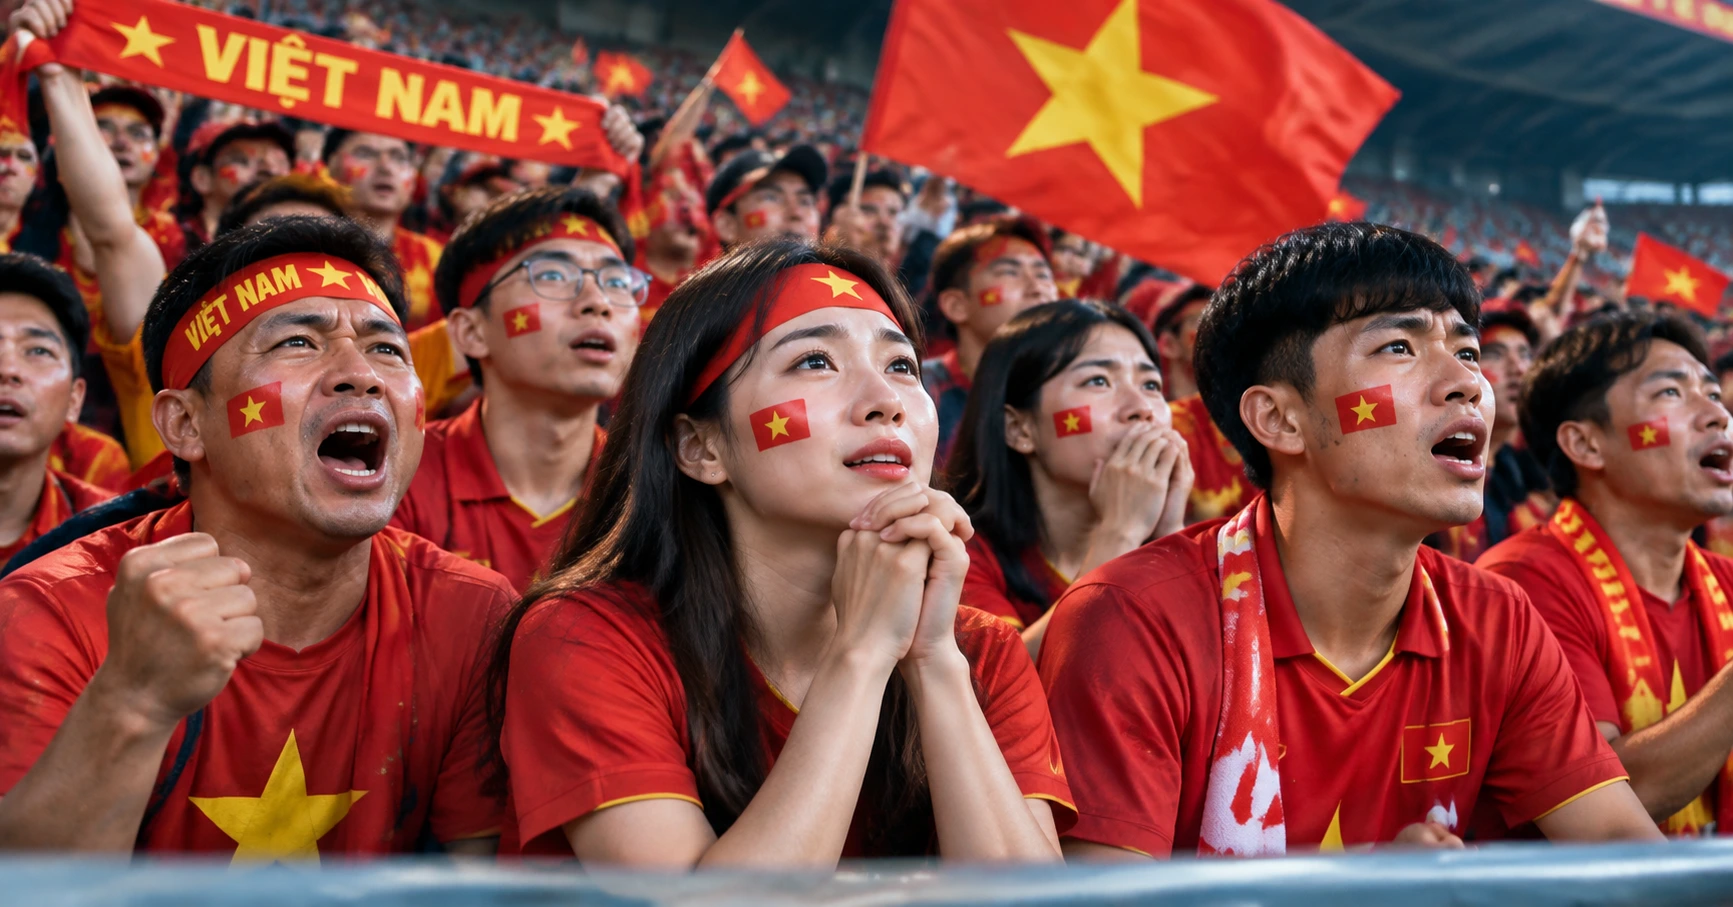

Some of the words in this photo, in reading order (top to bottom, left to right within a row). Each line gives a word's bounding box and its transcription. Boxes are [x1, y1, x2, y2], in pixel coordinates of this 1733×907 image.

[197, 24, 358, 108] VIỆT
[375, 67, 522, 142] NAM
[184, 294, 231, 351] VIỆT
[234, 264, 303, 312] NAM
